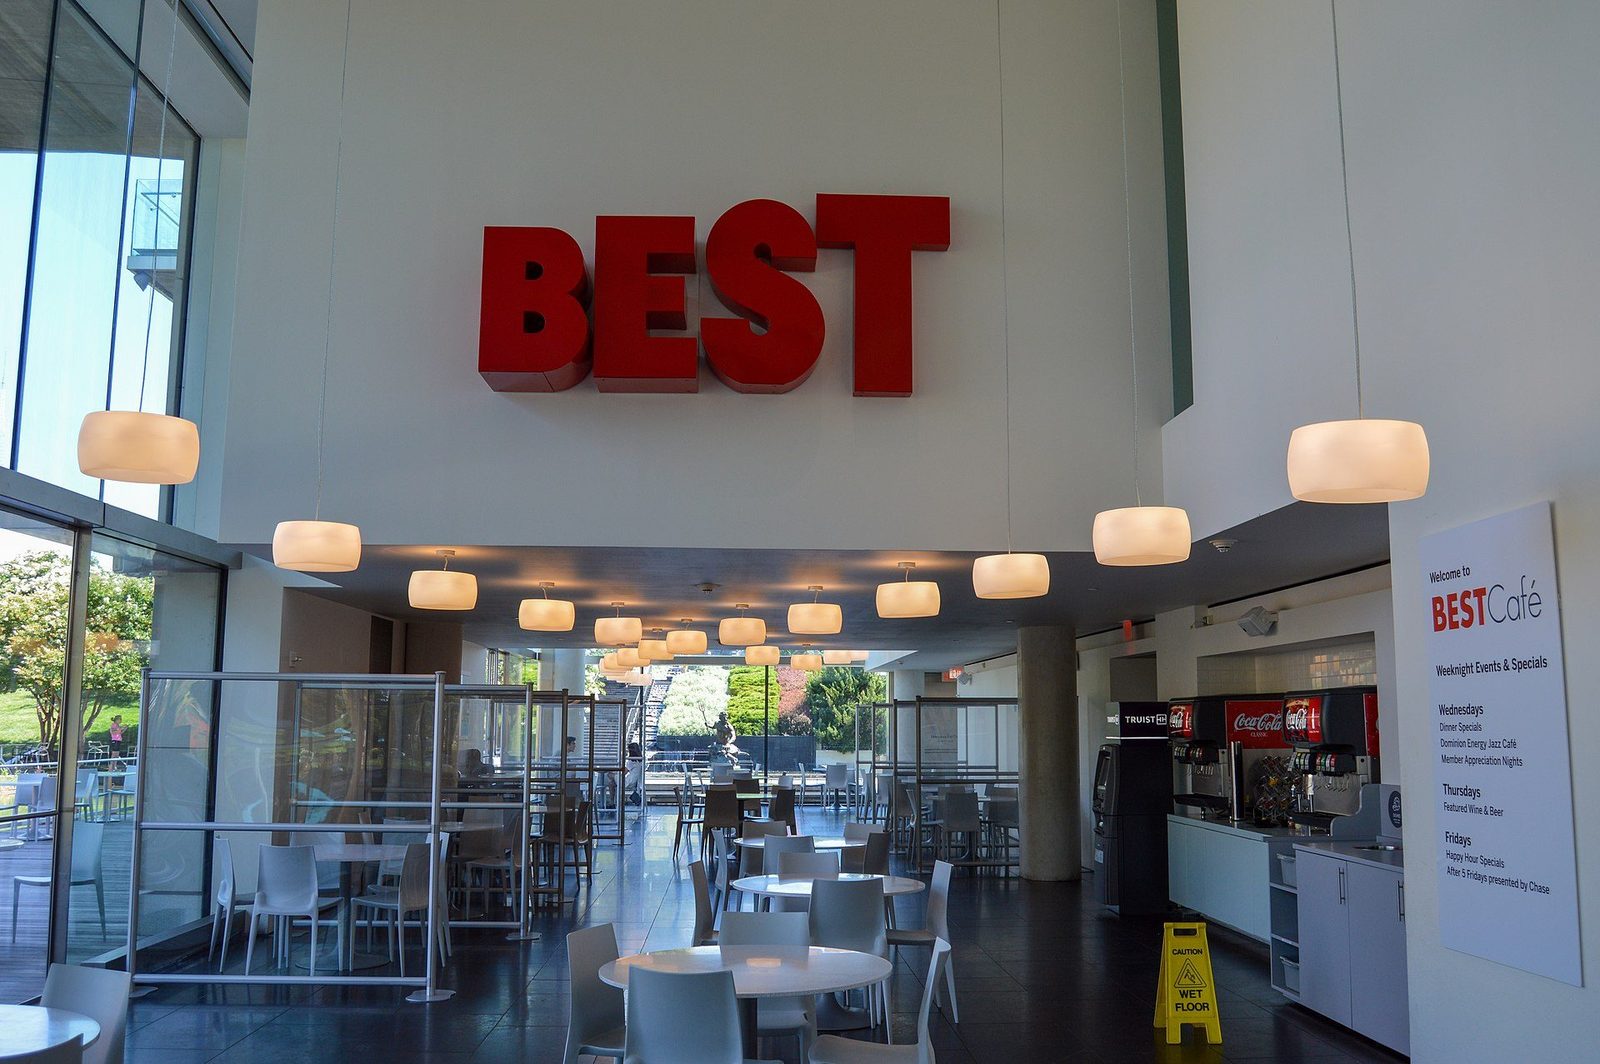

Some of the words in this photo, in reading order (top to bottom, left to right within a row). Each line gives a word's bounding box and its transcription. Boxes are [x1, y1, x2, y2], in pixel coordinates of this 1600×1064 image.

[479, 192, 951, 397] BEST
[1429, 567, 1461, 584] Welcome
[1462, 565, 1471, 577] to
[1436, 662, 1474, 677] Weeknight
[1475, 660, 1502, 673] Events
[1503, 659, 1510, 671] &
[1511, 655, 1548, 673] Specials
[1438, 703, 1484, 717] Wednesdays
[1124, 715, 1156, 724] TRUIST
[1439, 722, 1458, 732] Dinner
[1458, 722, 1482, 733] Specials
[1440, 738, 1467, 748] Dominion
[1467, 739, 1487, 750] Energy
[1488, 739, 1501, 749] Jazz
[1502, 738, 1517, 749] Café
[1441, 754, 1464, 764] Member
[1464, 755, 1501, 767] Appreciation
[1502, 756, 1523, 769] Nights
[1443, 783, 1481, 800] Thursdays
[1443, 801, 1468, 814] Featured
[1468, 804, 1483, 815] Wine
[1483, 805, 1489, 816] &
[1489, 806, 1504, 817] Beer
[1445, 831, 1472, 847] Fridays
[1445, 849, 1464, 863] Happy
[1464, 852, 1479, 864] Hour
[1479, 854, 1505, 869] Specials
[1446, 865, 1461, 877] After
[1461, 868, 1466, 878] 5
[1466, 869, 1488, 884] Fridays
[1488, 873, 1520, 889] presented
[1520, 877, 1529, 892] by
[1529, 880, 1550, 895] Chase
[1172, 948, 1203, 956] CAUTION
[1179, 990, 1203, 998] WET
[1175, 1003, 1210, 1011] FLOOR
